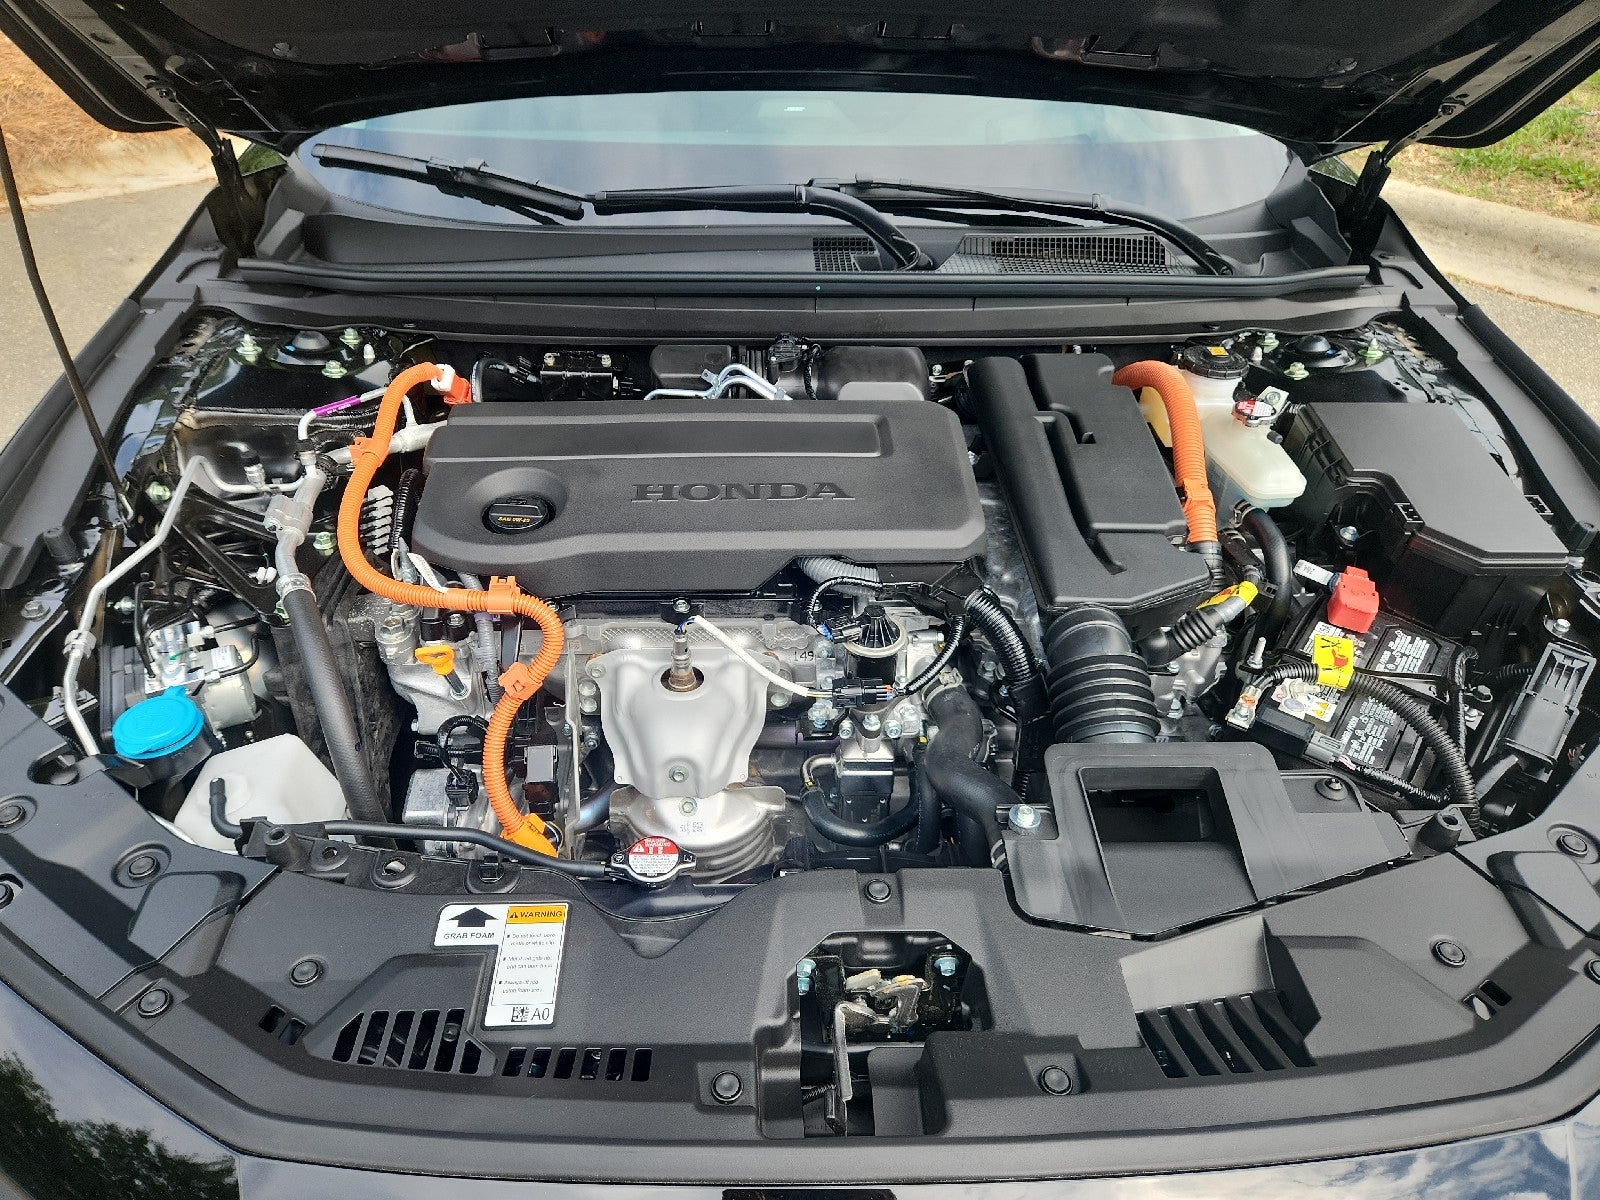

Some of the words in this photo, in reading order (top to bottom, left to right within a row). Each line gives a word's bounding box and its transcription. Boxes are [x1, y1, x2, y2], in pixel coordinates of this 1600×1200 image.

[631, 483, 855, 502] HONDA
[794, 651, 814, 661] 149
[531, 1007, 550, 1021] A0
